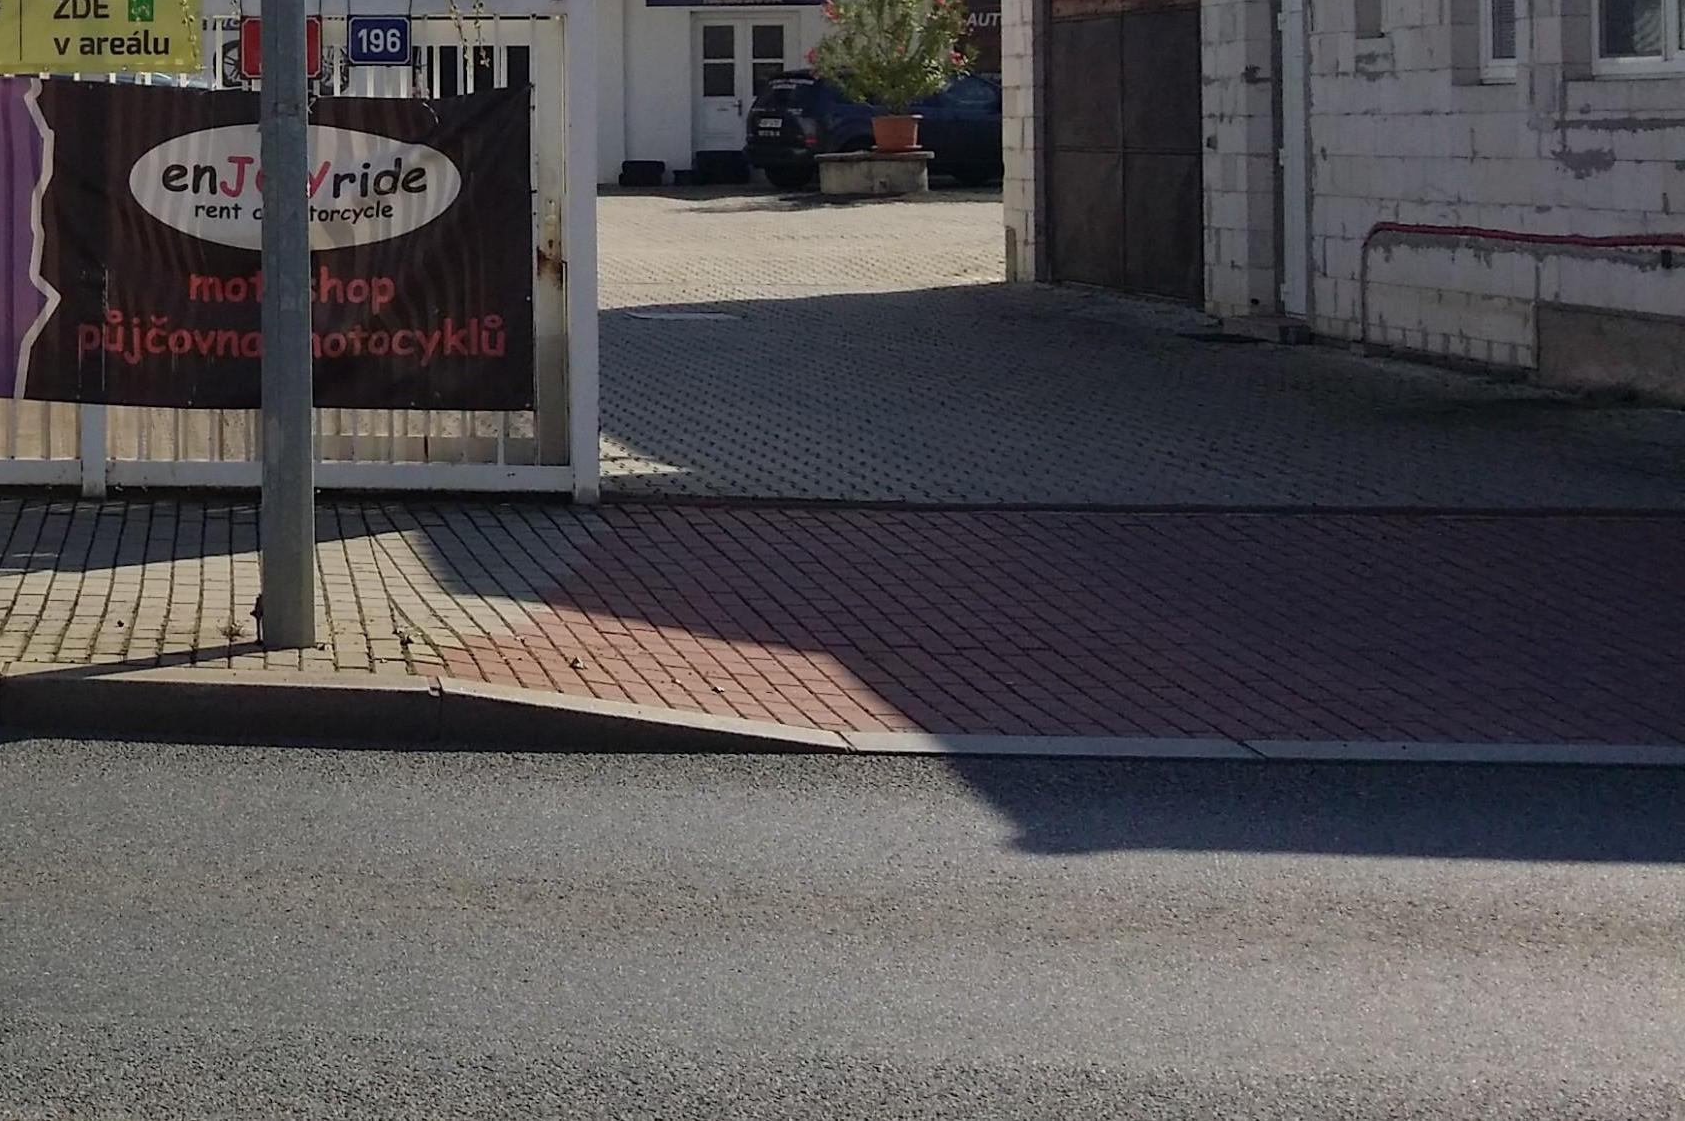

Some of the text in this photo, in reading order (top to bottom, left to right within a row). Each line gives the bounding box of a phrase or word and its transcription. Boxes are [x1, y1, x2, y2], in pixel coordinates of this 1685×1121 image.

[53, 31, 170, 56] v areálu
[357, 28, 401, 54] 196
[194, 202, 242, 220] rent
[78, 310, 264, 364] půjčovna
